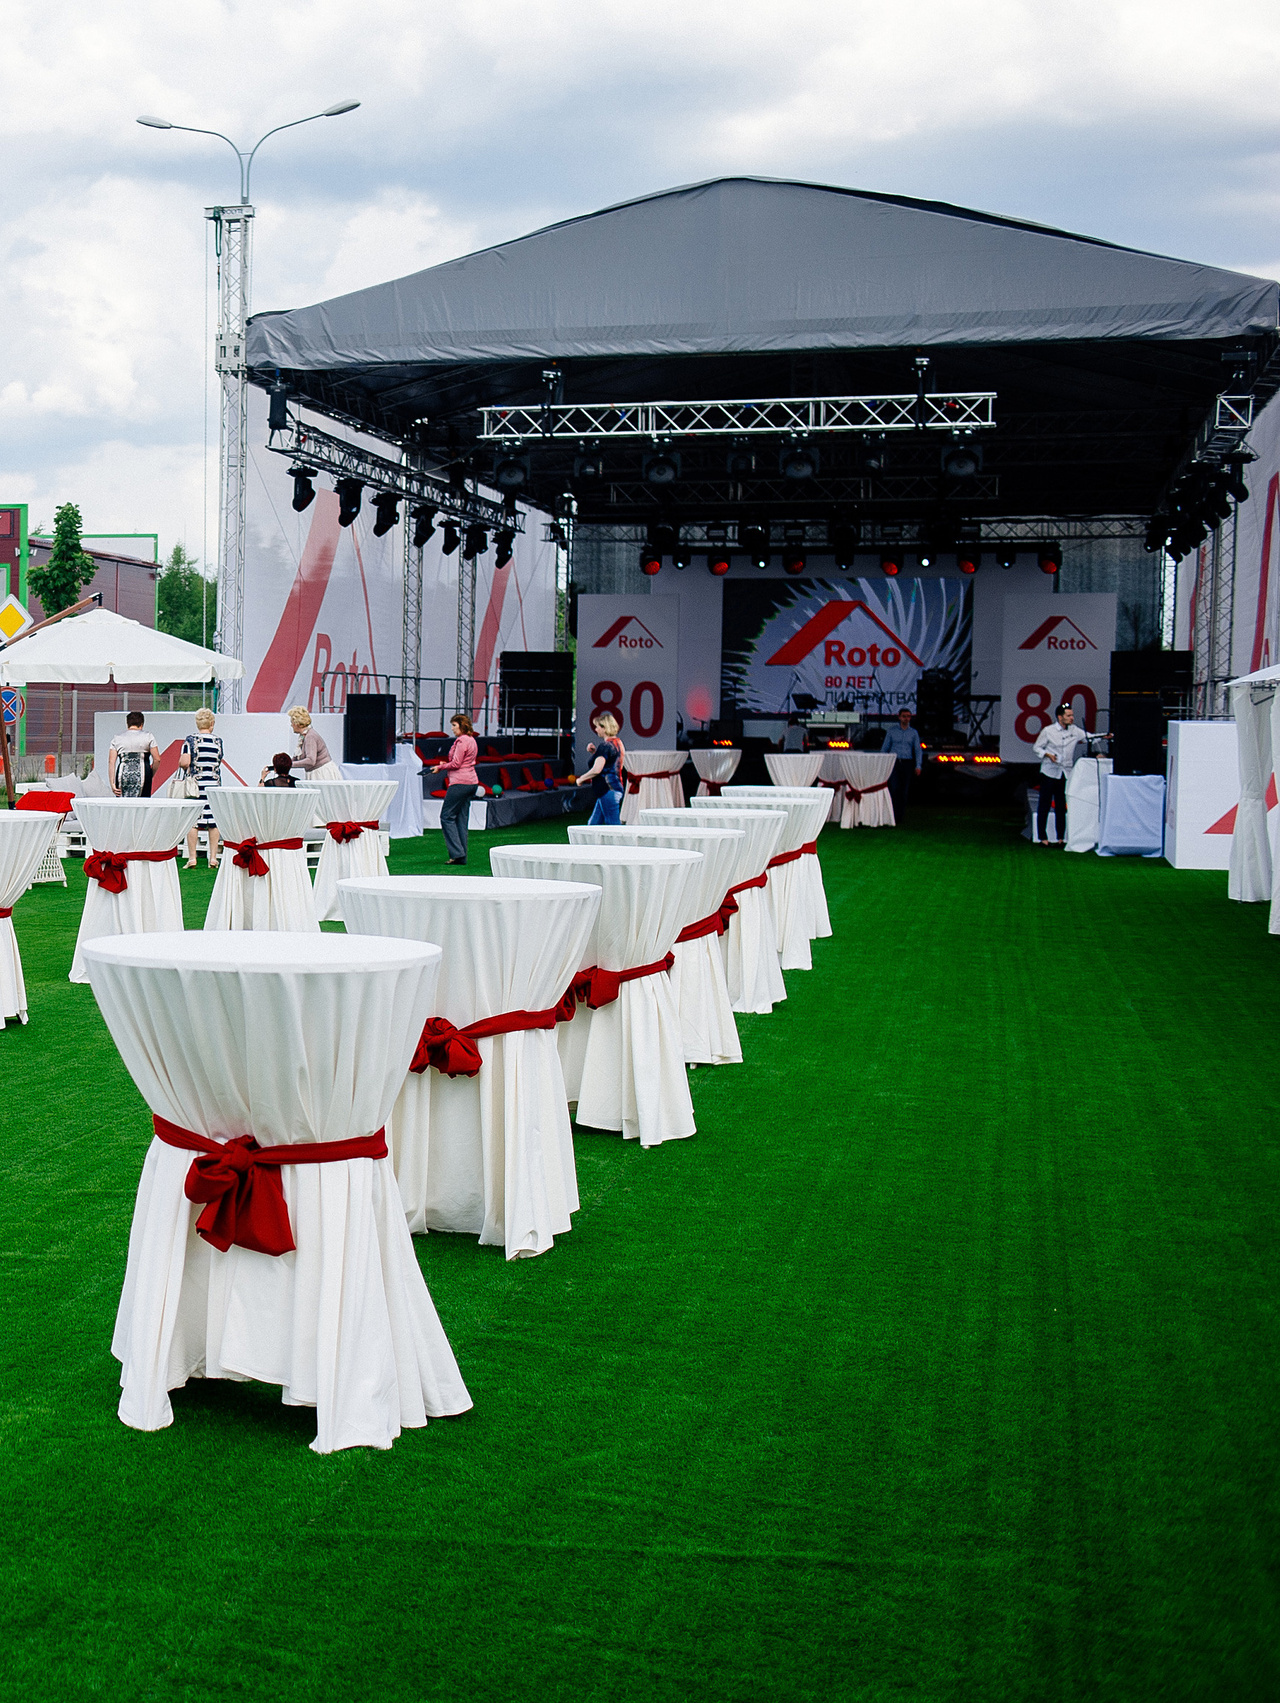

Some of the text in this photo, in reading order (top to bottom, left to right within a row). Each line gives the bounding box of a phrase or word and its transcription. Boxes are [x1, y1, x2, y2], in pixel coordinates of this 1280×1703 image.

[618, 634, 654, 649] Roto
[1047, 635, 1086, 651] Roto
[824, 639, 901, 667] Roto
[824, 675, 875, 690] 80 ЛЕТ
[589, 680, 664, 738] 80
